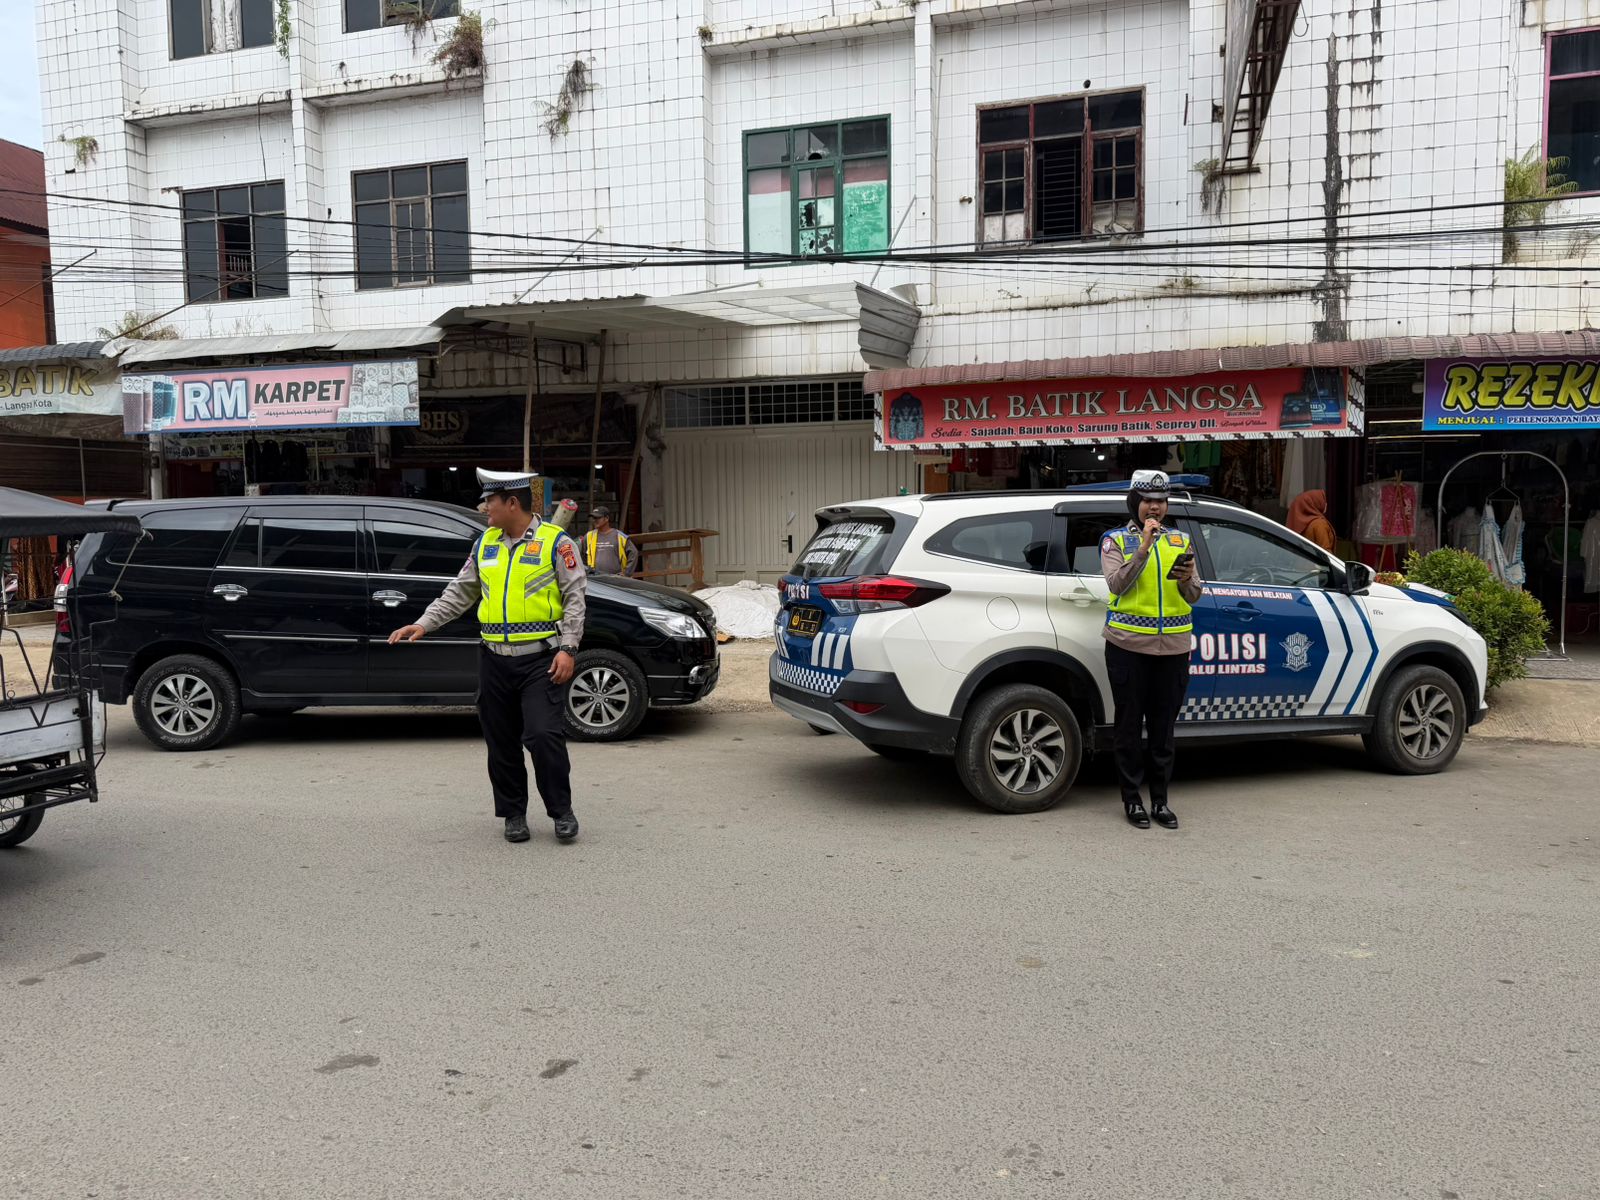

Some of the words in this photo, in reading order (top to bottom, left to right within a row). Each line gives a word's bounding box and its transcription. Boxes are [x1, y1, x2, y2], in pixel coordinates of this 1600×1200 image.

[0, 365, 99, 398] BATIK
[33, 399, 53, 409] Kota
[183, 378, 248, 422] RM
[254, 379, 346, 405] KARPET
[943, 396, 997, 422] RM.
[1006, 391, 1107, 419] BATIK
[1115, 382, 1265, 417] LANGSA
[420, 410, 460, 431] BHS
[931, 427, 962, 438] Sedia
[1018, 425, 1044, 436] Baju
[1078, 422, 1118, 434] Sarung
[1155, 420, 1197, 432] Seprey
[1437, 415, 1497, 425] MENJUAL
[1507, 415, 1580, 425] PERLENGKAPAN
[1581, 415, 1600, 424] BAY
[1250, 589, 1263, 598] DAN
[1263, 590, 1293, 600] MELAYANI
[1188, 633, 1267, 661] POLISI
[1188, 664, 1216, 675] ALU
[1217, 663, 1266, 674] LINTAS
